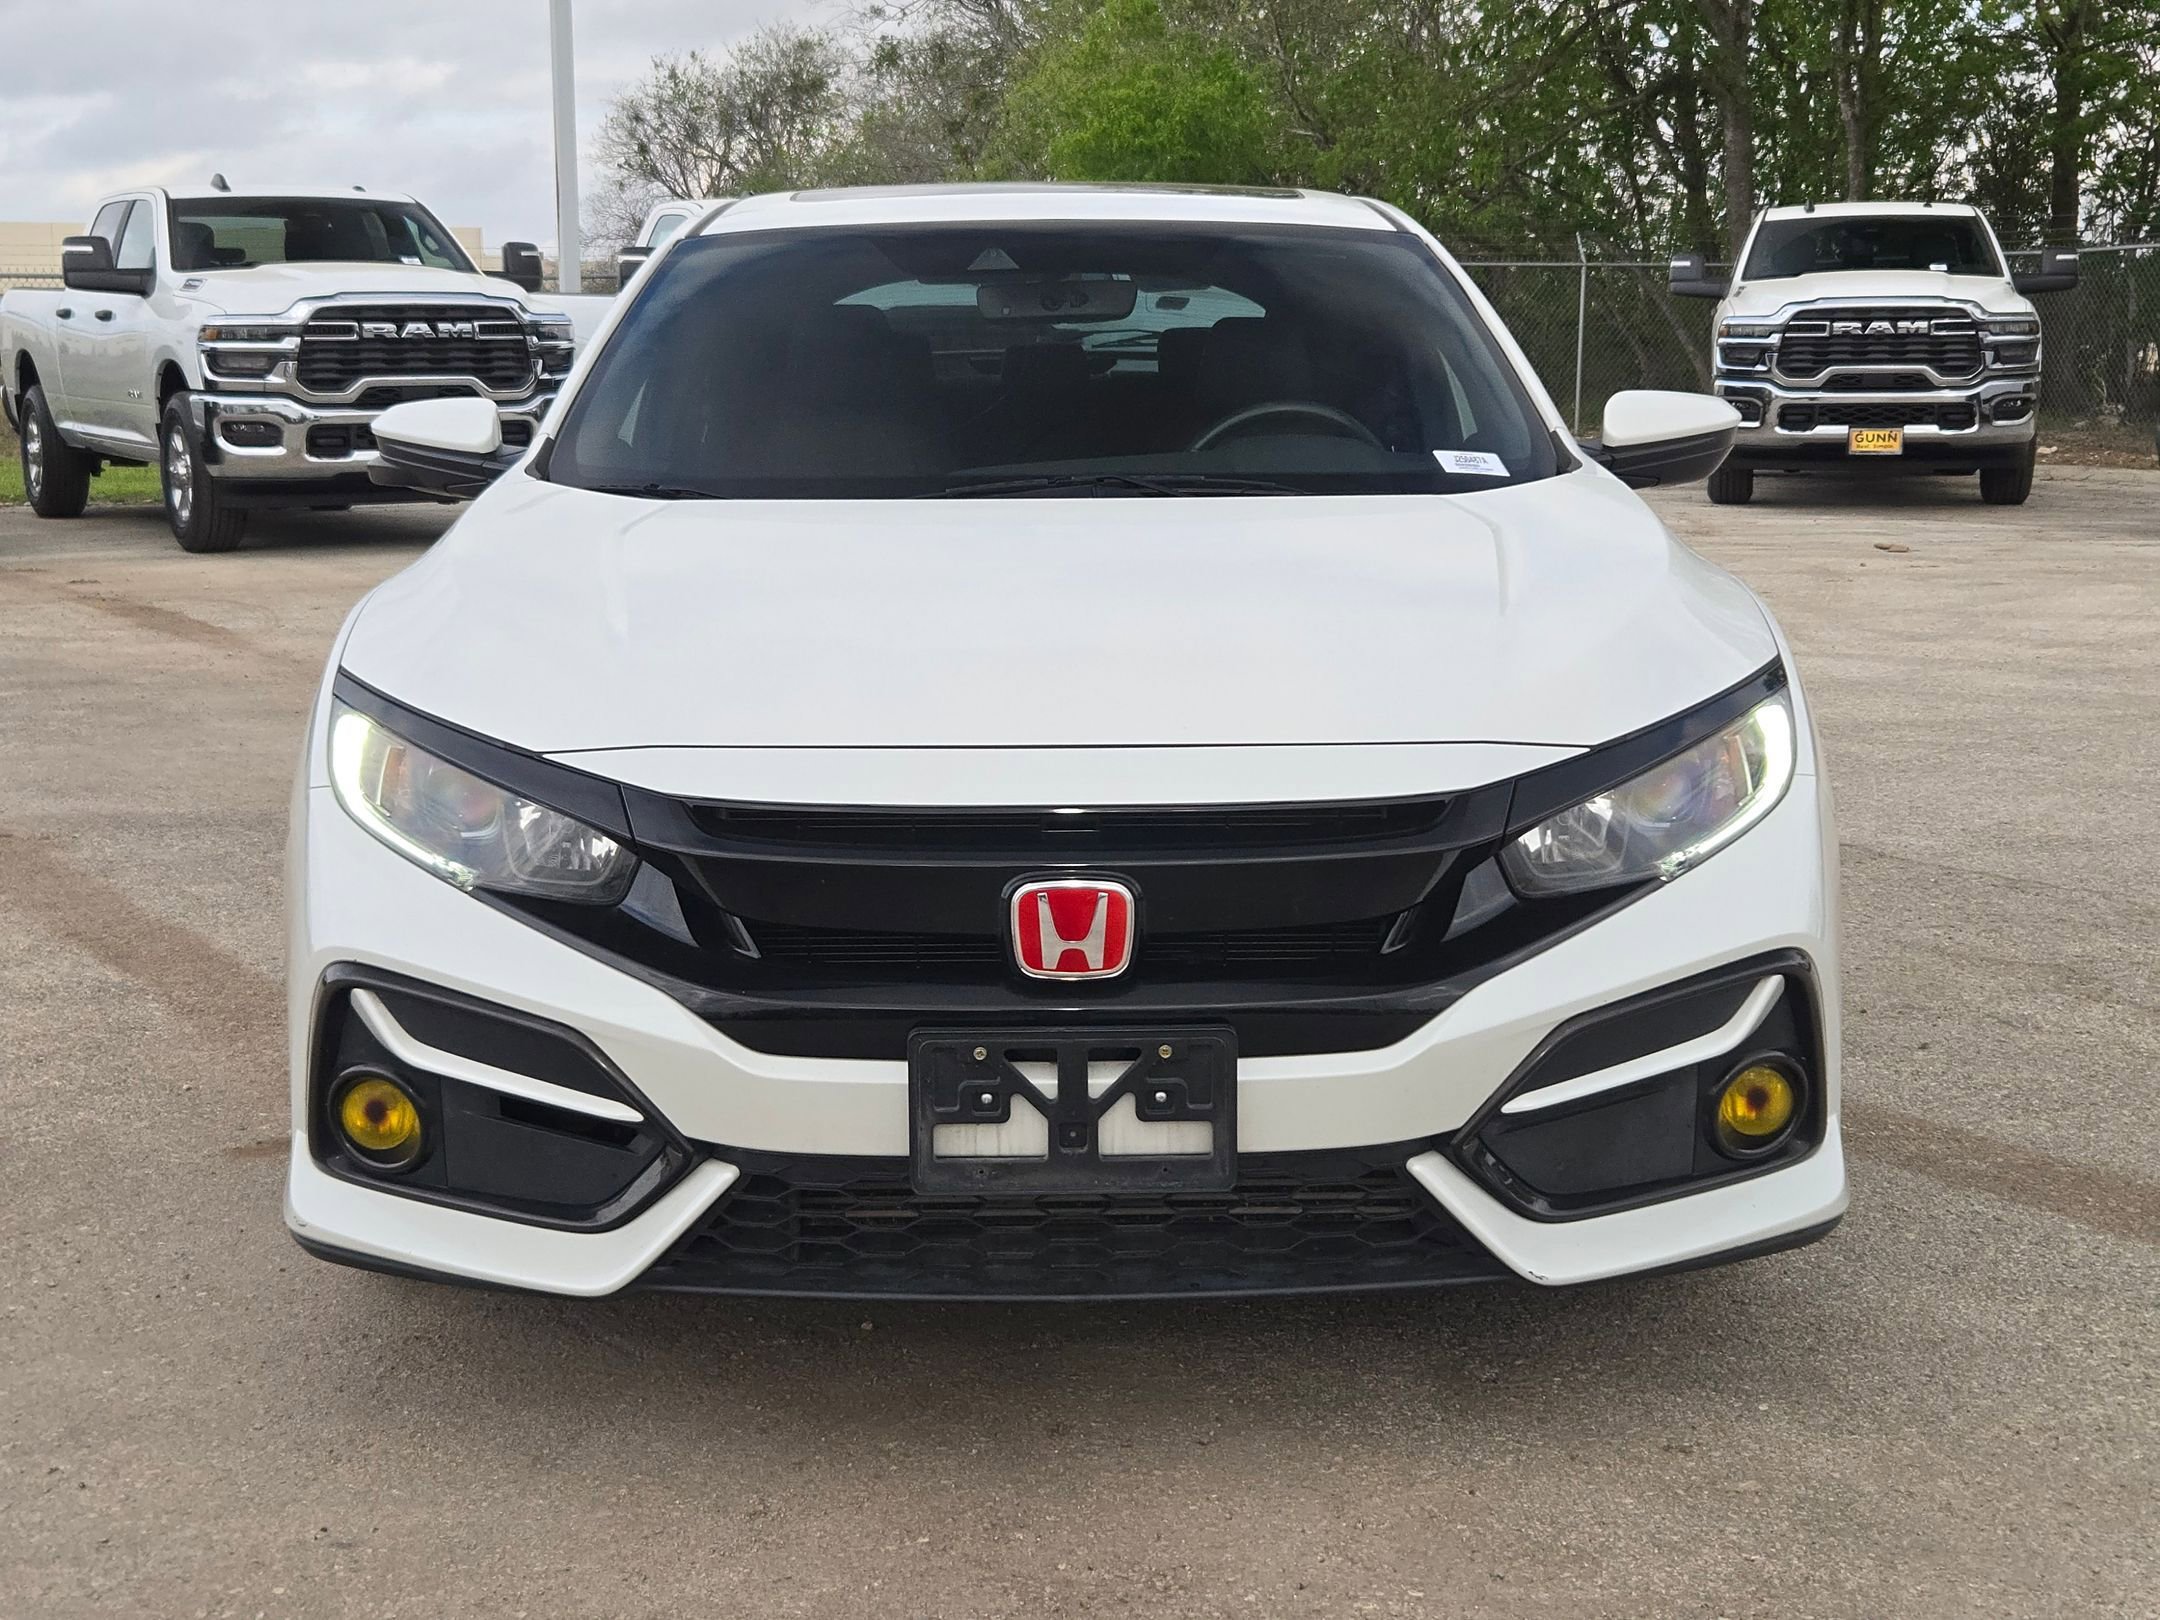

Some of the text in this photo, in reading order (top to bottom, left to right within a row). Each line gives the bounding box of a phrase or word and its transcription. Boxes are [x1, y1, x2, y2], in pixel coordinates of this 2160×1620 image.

[362, 321, 473, 339] RAM
[1832, 320, 1928, 335] RAM
[1855, 433, 1897, 443] GUNN
